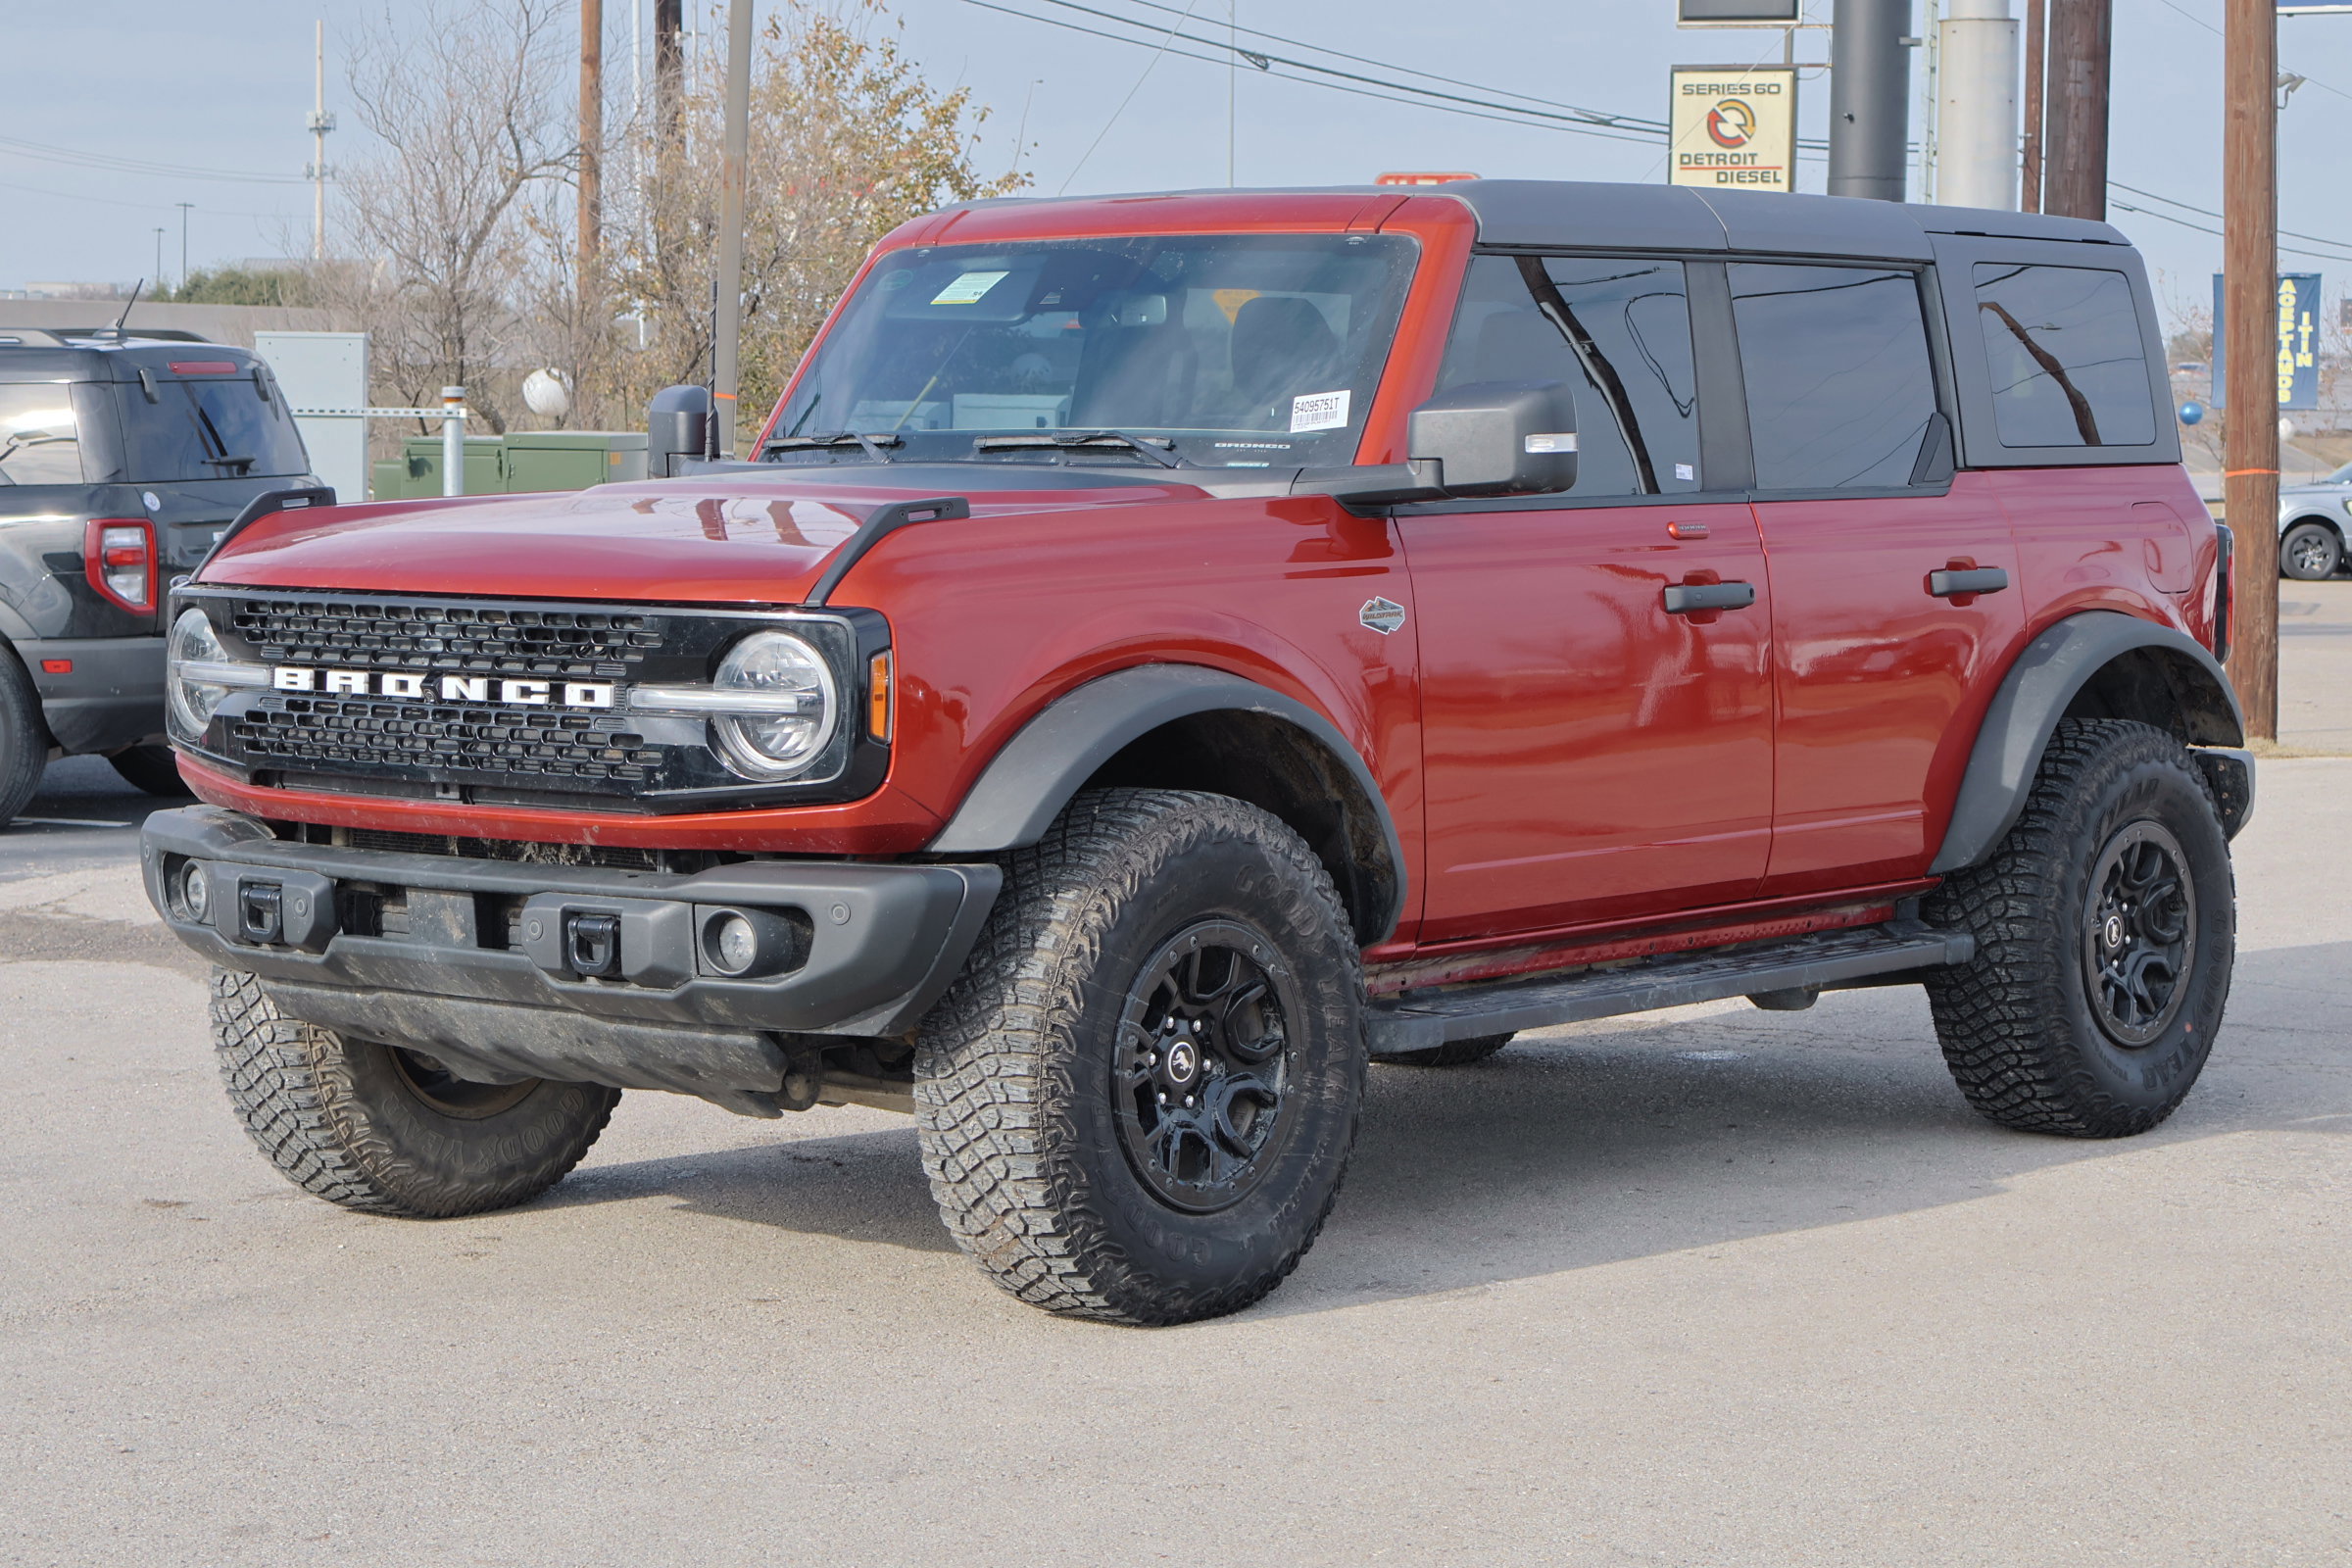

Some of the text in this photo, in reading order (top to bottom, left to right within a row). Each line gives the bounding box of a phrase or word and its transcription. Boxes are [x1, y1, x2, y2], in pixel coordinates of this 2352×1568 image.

[1682, 83, 1782, 95] SERIES 60
[1680, 153, 1758, 166] DETROIT
[1716, 171, 1782, 183] DIESEL
[2296, 311, 2314, 368] ITIN
[1294, 397, 1340, 415] 54095751T
[274, 667, 614, 708] BRONCO
